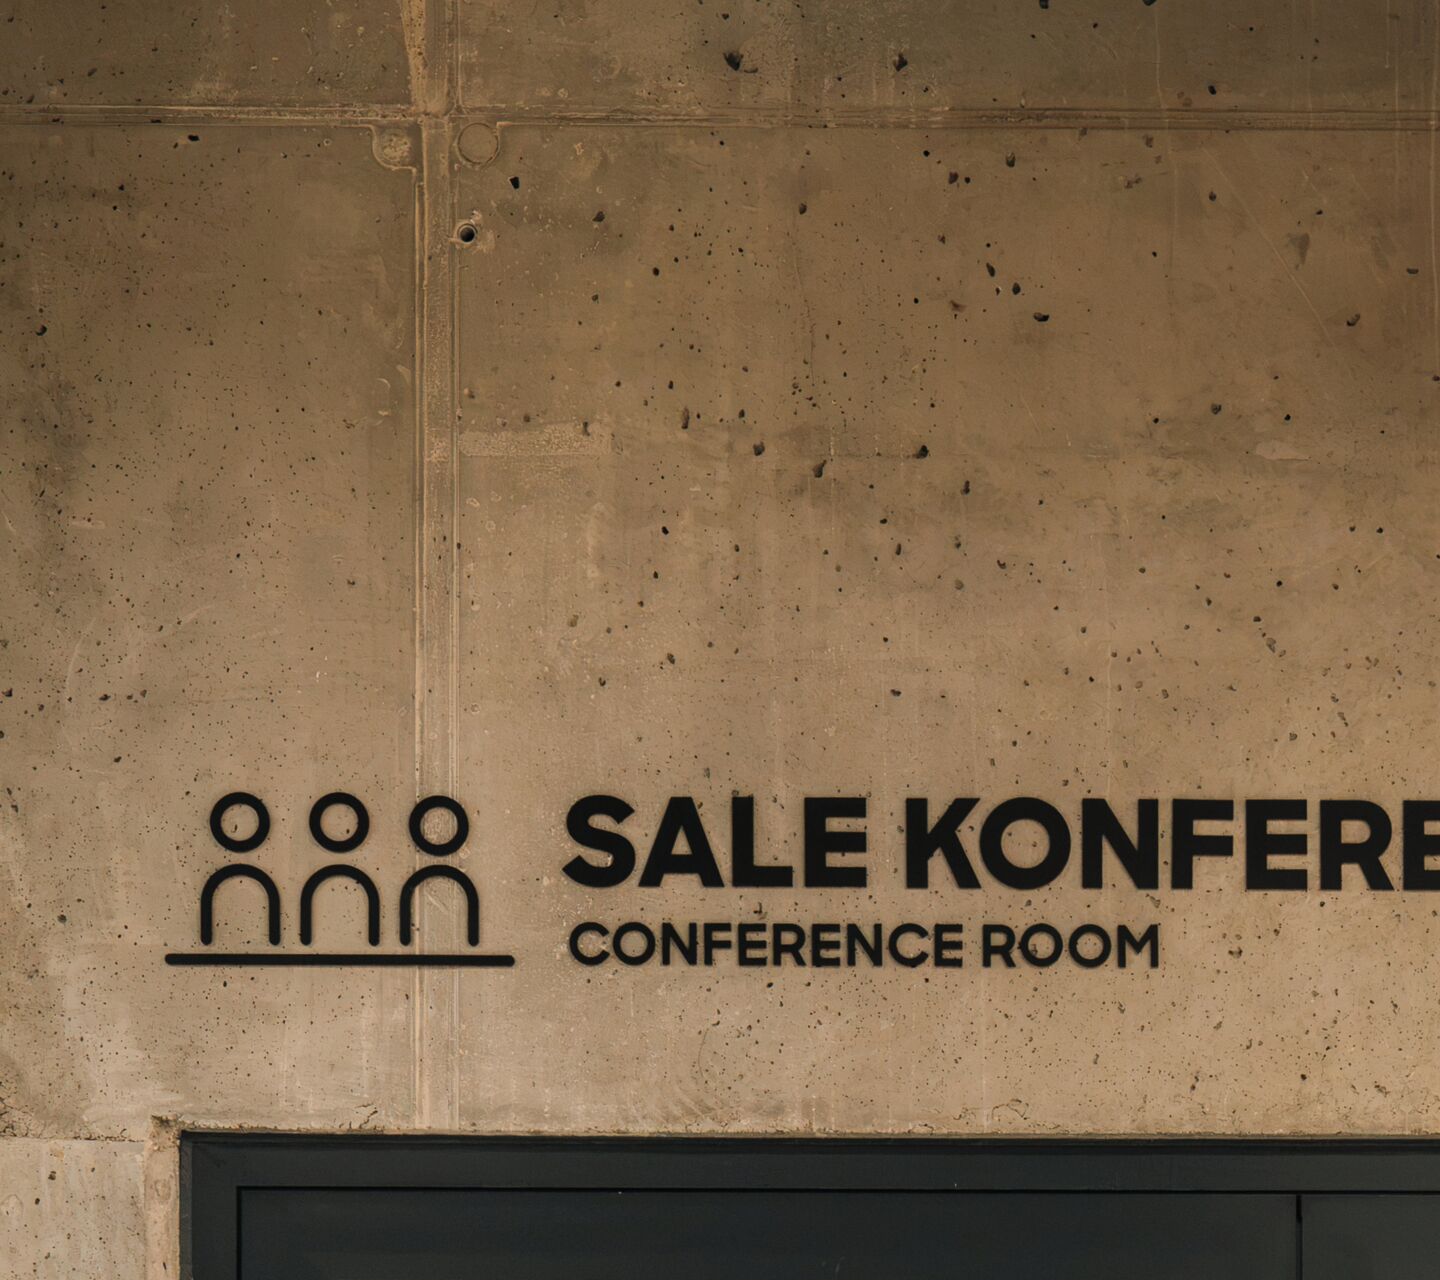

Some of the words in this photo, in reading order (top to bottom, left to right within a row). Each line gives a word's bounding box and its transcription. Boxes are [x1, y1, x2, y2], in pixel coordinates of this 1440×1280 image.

[563, 795, 868, 889] SALE
[569, 922, 964, 968] CONFERENCE
[982, 923, 1160, 968] ROOM
